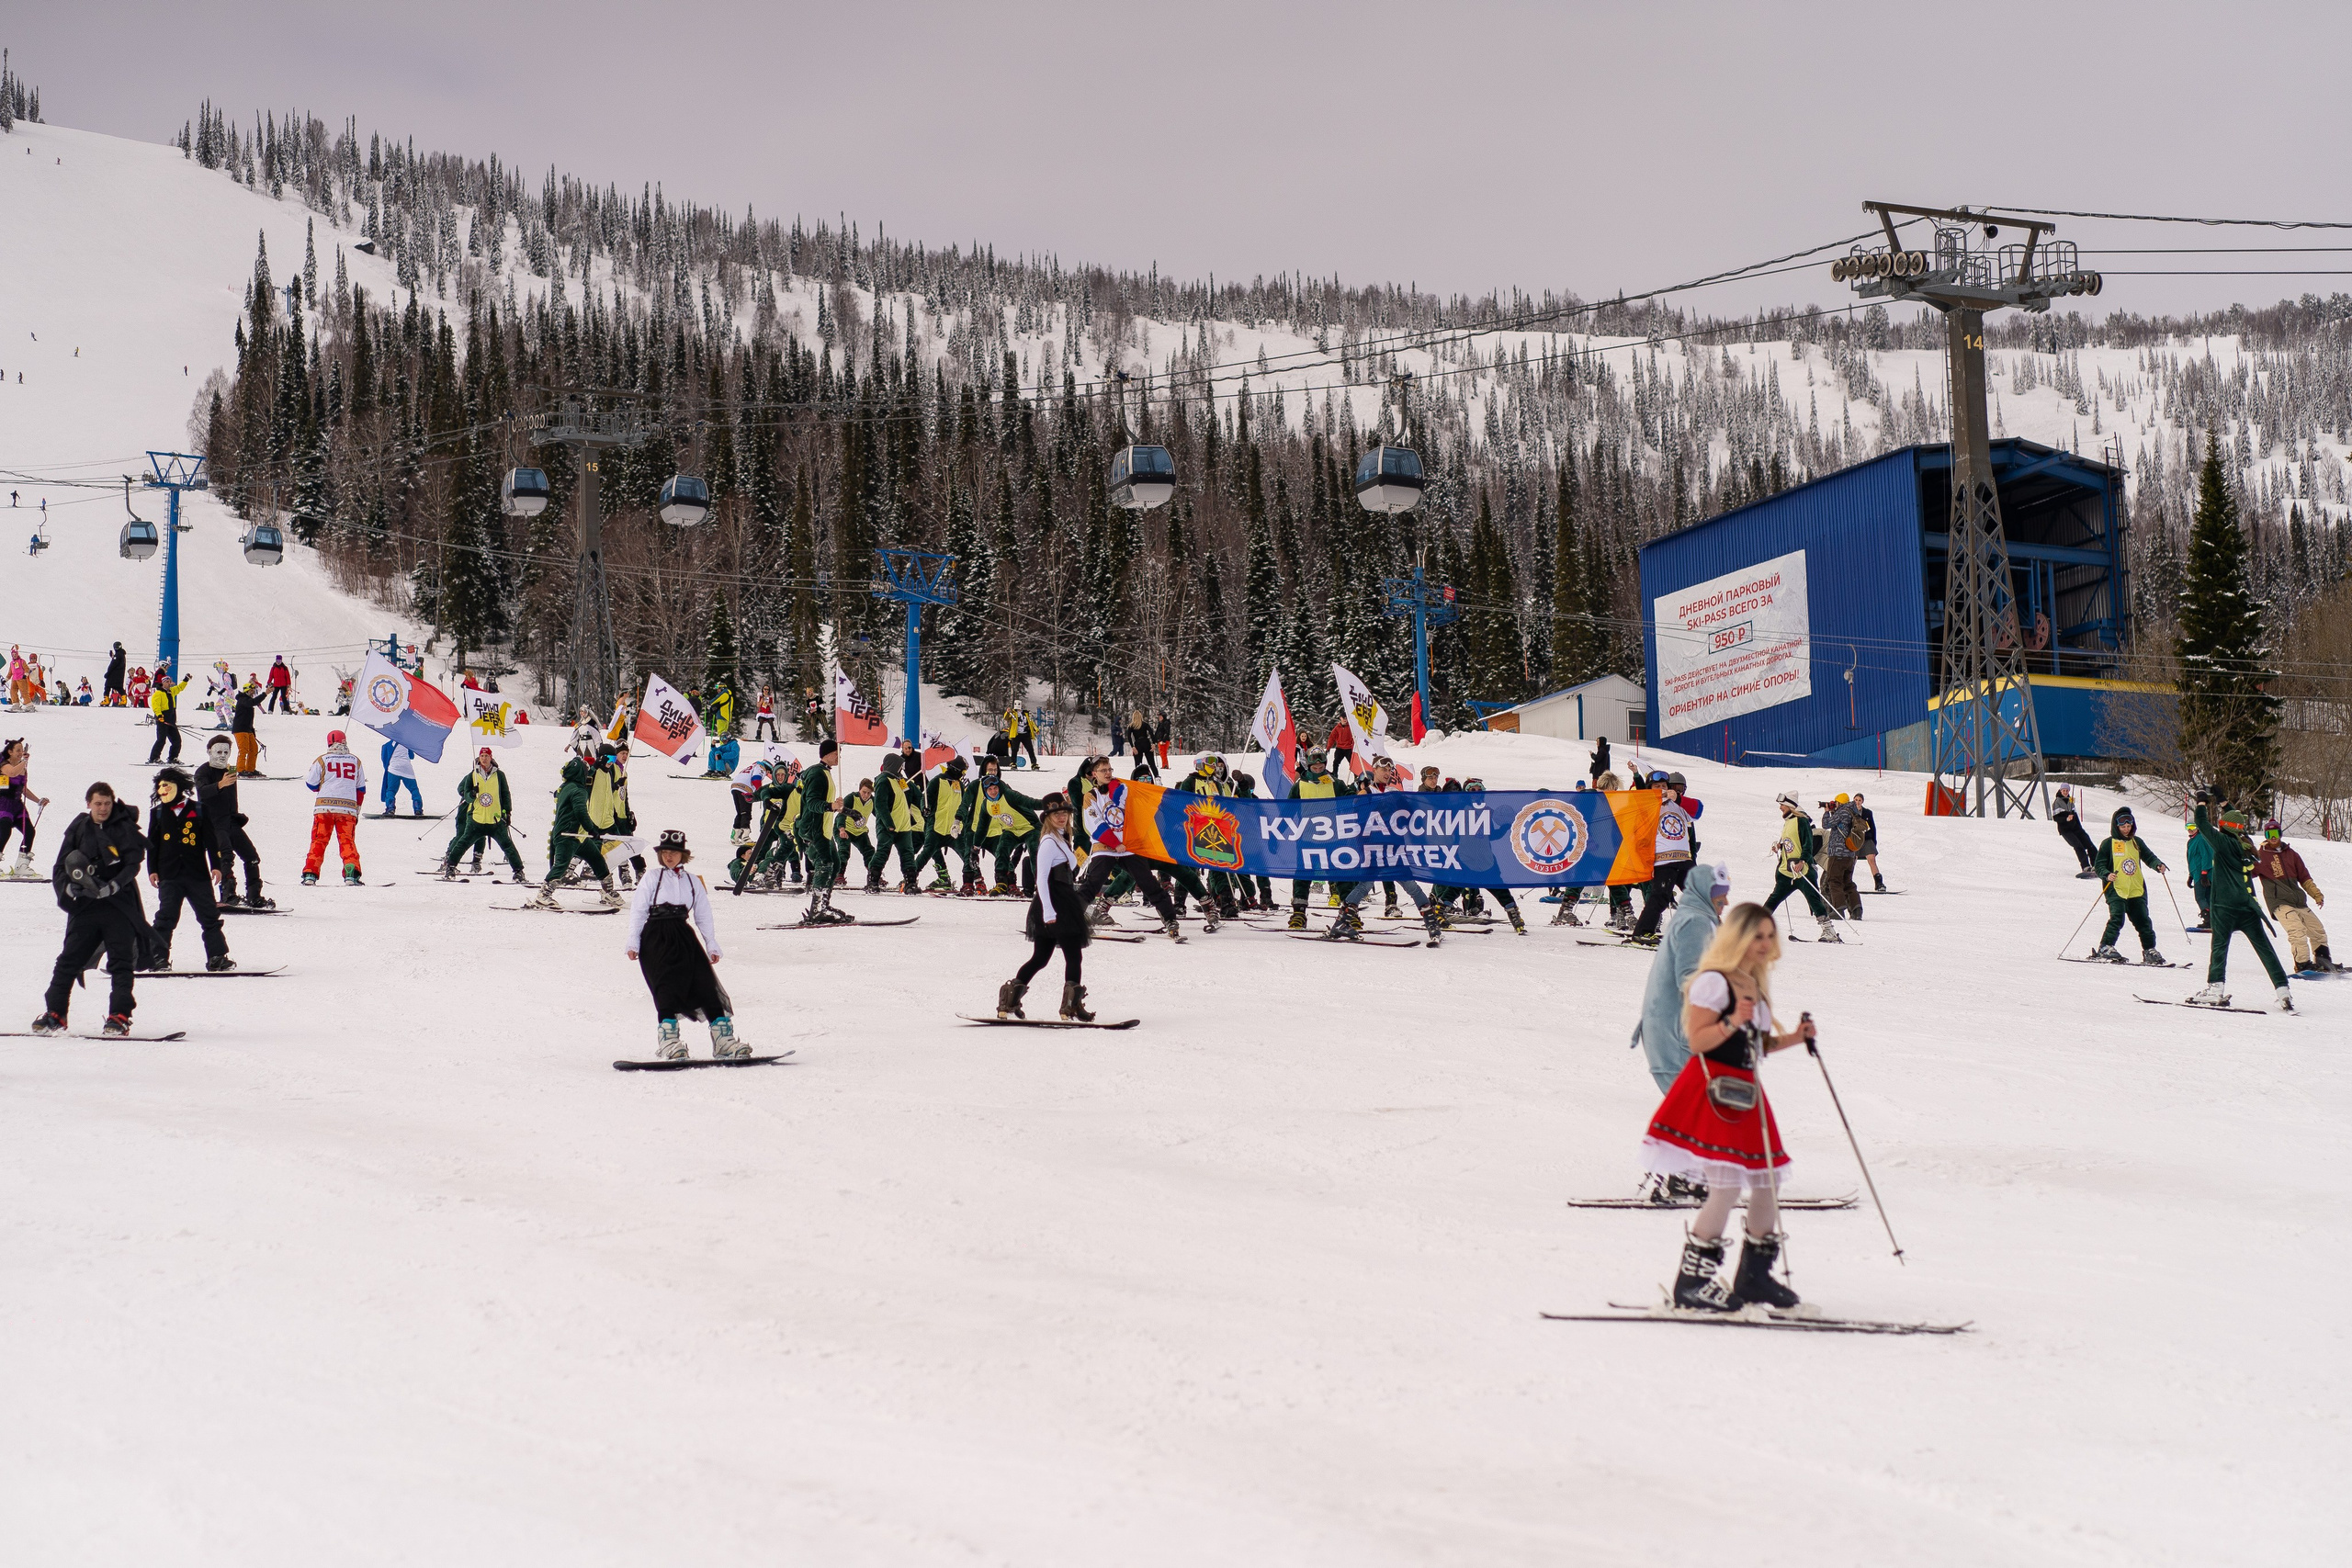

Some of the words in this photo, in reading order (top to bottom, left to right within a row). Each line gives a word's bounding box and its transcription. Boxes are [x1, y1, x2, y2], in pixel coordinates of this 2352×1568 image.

[1963, 333, 1984, 351] 14
[585, 461, 599, 472] 15
[1679, 591, 1724, 619] ДНЕВНОЙ
[1725, 572, 1781, 602] ПАРКОВЫЙ
[1687, 608, 1726, 631] SKI-PASS
[1728, 598, 1758, 616] ВСЕГО
[1760, 593, 1773, 607] ЗА
[1714, 630, 1735, 649] 950
[1664, 673, 1687, 687] SKI-PASS
[1688, 662, 1718, 681] ДЕЙСТВУЕТ
[1719, 660, 1727, 669] НА
[1728, 646, 1770, 668] ДВУХМЕСТНОЙ
[1770, 637, 1802, 654] КАНАТНОЙ
[1673, 682, 1695, 694] ДОРОГЕ
[1701, 669, 1733, 685] БУГЕЛЬНЫХ
[1734, 660, 1765, 673] КАНАТНЫХ
[1766, 651, 1792, 665] ДОРОГАХ
[1668, 694, 1714, 717] ОРИЕНТИР
[1716, 691, 1728, 703] НА
[1730, 680, 1761, 698] СИНИЕ
[1763, 669, 1800, 689] ОПОРЫ!
[659, 709, 691, 739] ТЕРРА
[660, 699, 695, 728] ДИНО
[848, 698, 880, 730] ТЕРР
[327, 761, 356, 781] 42
[1259, 802, 1491, 841] КУЗБАССКИЙ
[1302, 844, 1463, 870] ПОЛИТЕХ
[1533, 863, 1565, 872] КУЗГТУ
